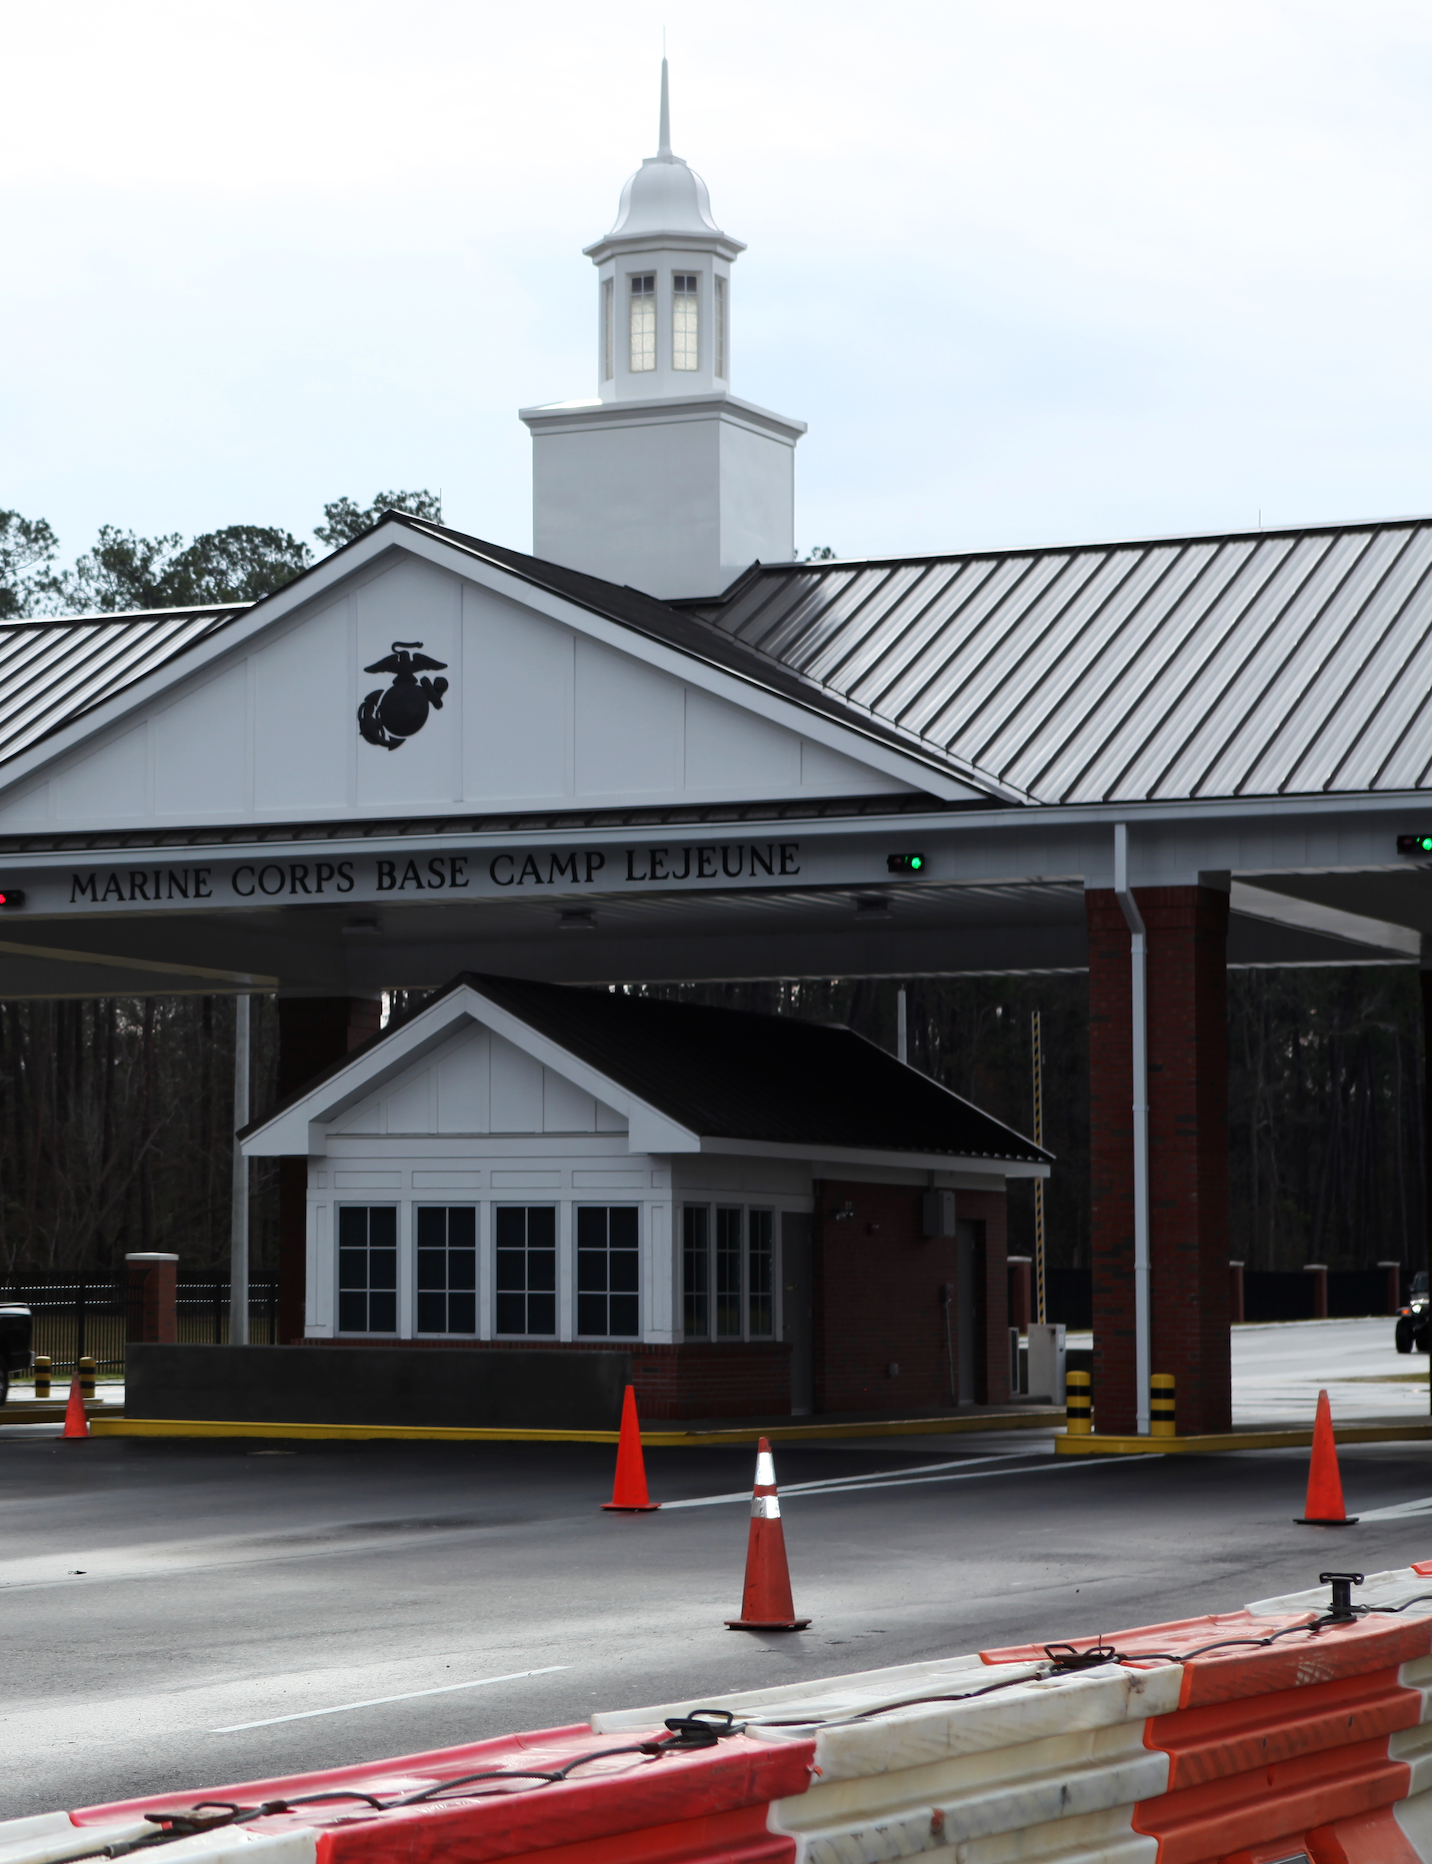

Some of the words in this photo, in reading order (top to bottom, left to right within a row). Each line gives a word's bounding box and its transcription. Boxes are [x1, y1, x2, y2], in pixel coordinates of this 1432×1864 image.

[69, 868, 213, 902] MARINE
[231, 861, 354, 896] CORPS
[375, 857, 469, 890] BASE
[489, 851, 605, 886] CAMP
[625, 843, 801, 881] LEJEUNE
